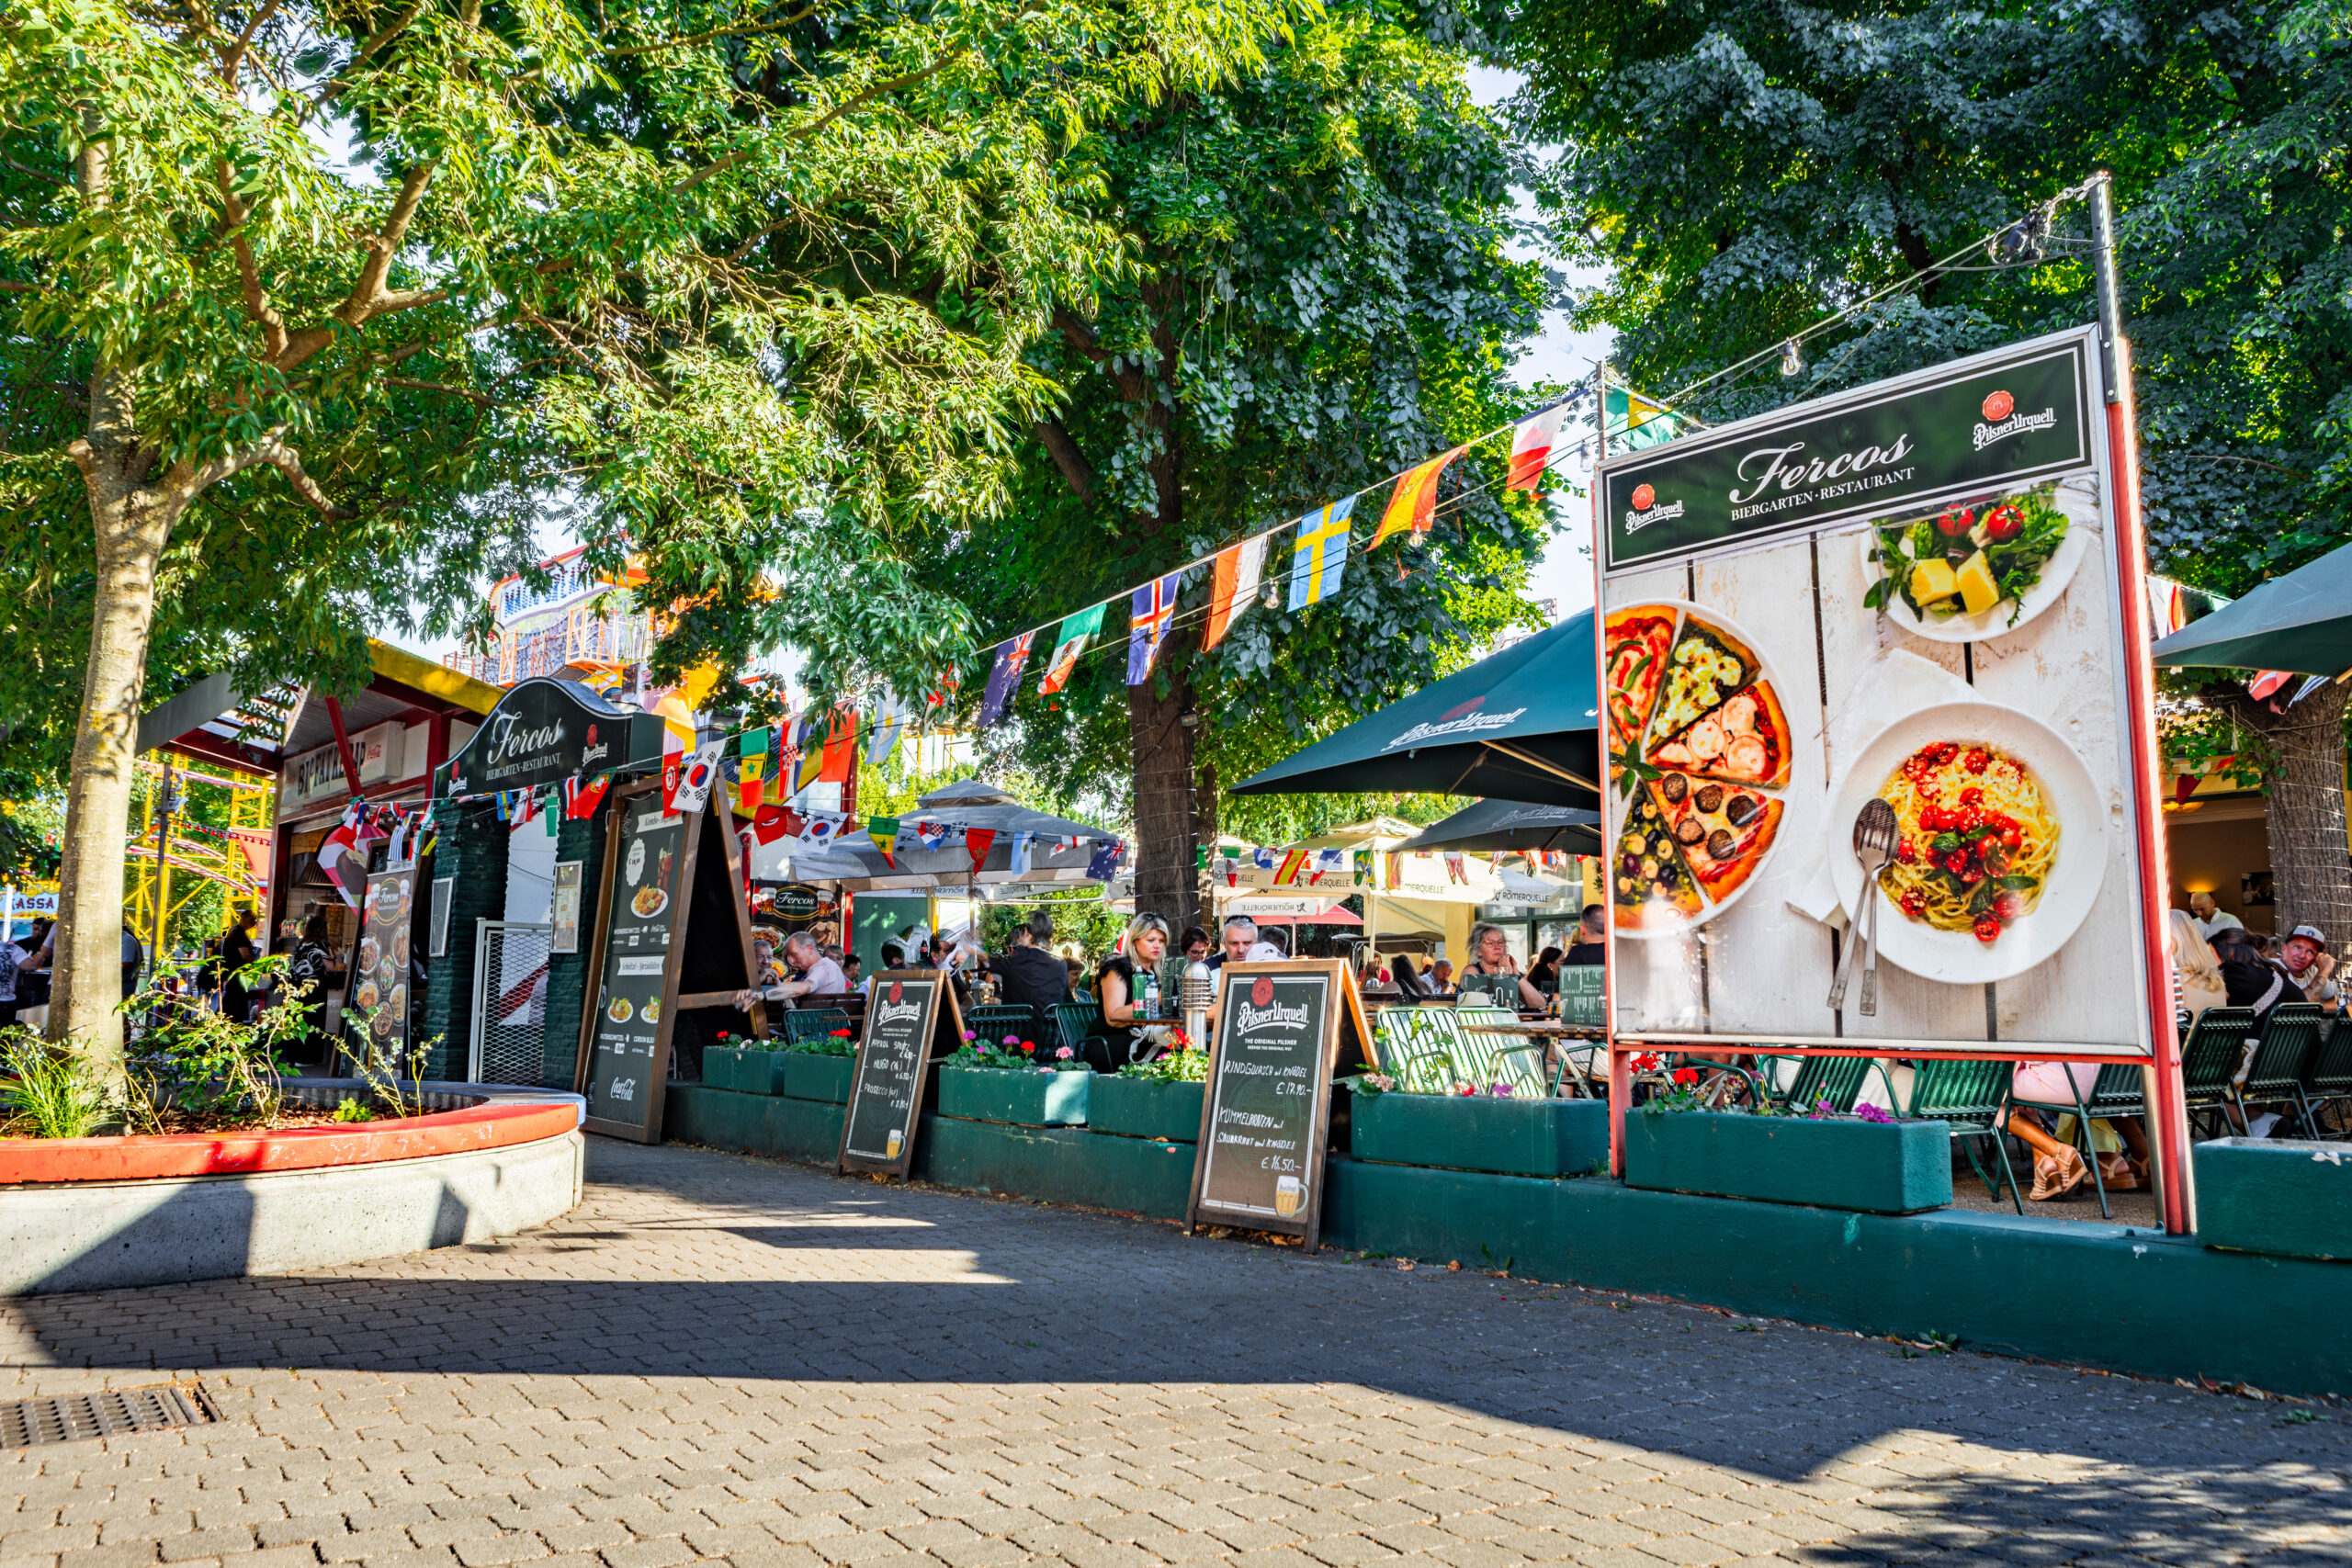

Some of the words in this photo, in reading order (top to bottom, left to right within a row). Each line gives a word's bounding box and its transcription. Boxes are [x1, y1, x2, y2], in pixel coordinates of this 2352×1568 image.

[1973, 421, 2015, 451] Pilsner
[1728, 433, 1914, 503] Fercos
[1731, 491, 1814, 521] BIERGARTEN
[1820, 467, 1915, 500] RESTAURANT
[1625, 509, 1657, 535] Pilsner
[487, 711, 562, 764] Fercos
[1381, 719, 1461, 751] Pilsner
[486, 762, 520, 781] BIERGARTEN
[522, 752, 561, 772] RESTAURANT
[379, 887, 399, 903] Fercos
[776, 892, 815, 905] Fercos
[878, 999, 901, 1026] Pilsner
[1237, 1001, 1274, 1036] Pilsner
[874, 1058, 889, 1069] HUGO
[865, 1083, 888, 1096] PROSECCO
